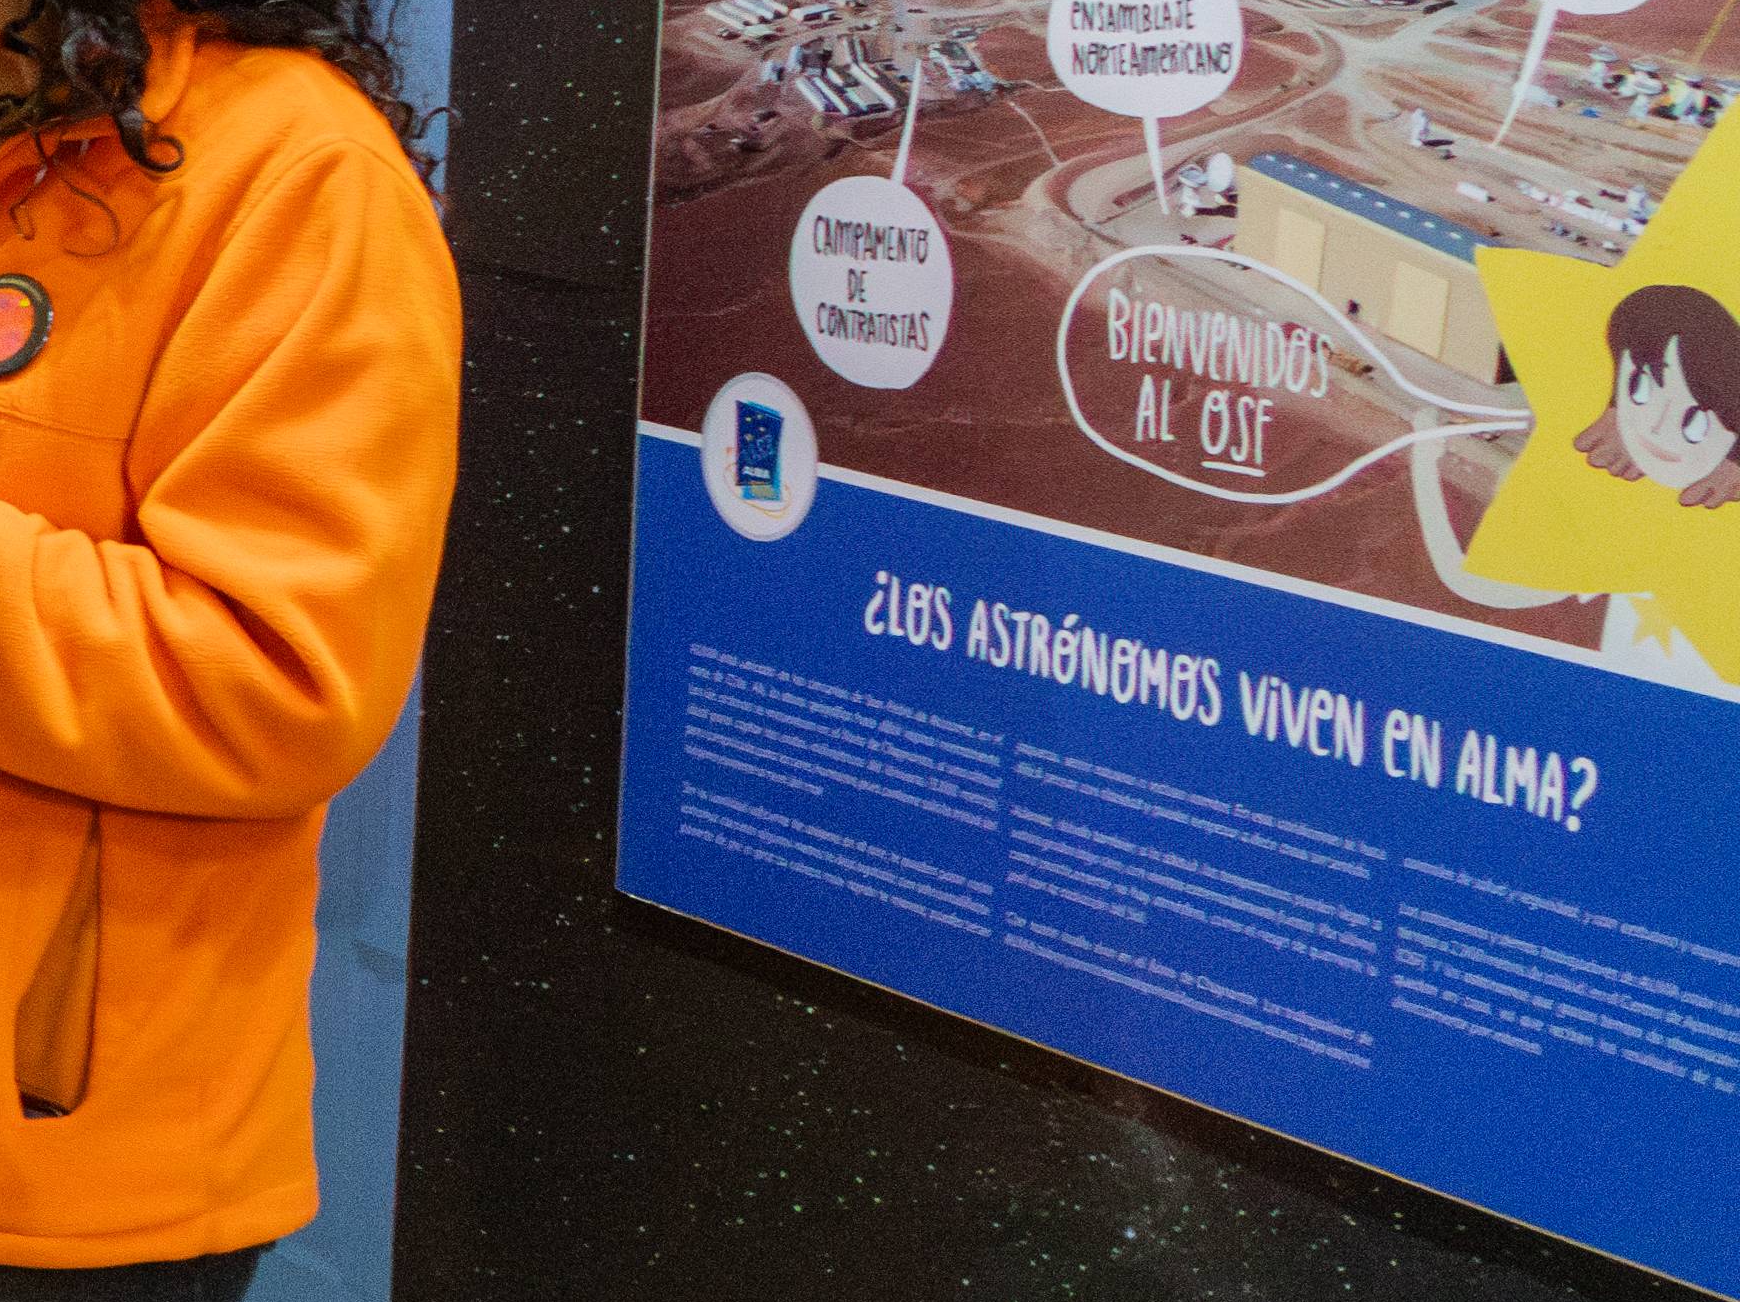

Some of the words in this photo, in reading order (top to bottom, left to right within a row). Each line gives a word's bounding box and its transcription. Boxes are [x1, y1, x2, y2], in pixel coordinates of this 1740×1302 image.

[813, 215, 929, 264] CAMPAMENTO
[847, 267, 868, 303] DE
[817, 302, 931, 351] CONTRATISTAS
[1107, 281, 1331, 399] BIENVENIDOS
[1136, 375, 1176, 443] AL
[1201, 395, 1274, 466] OSF
[864, 570, 953, 651] ¿LOS
[967, 598, 1223, 727] ASTRÓNOMOS
[1239, 670, 1364, 767] VIVEN
[1383, 708, 1441, 789] EN
[1456, 730, 1599, 833] ALMA?
